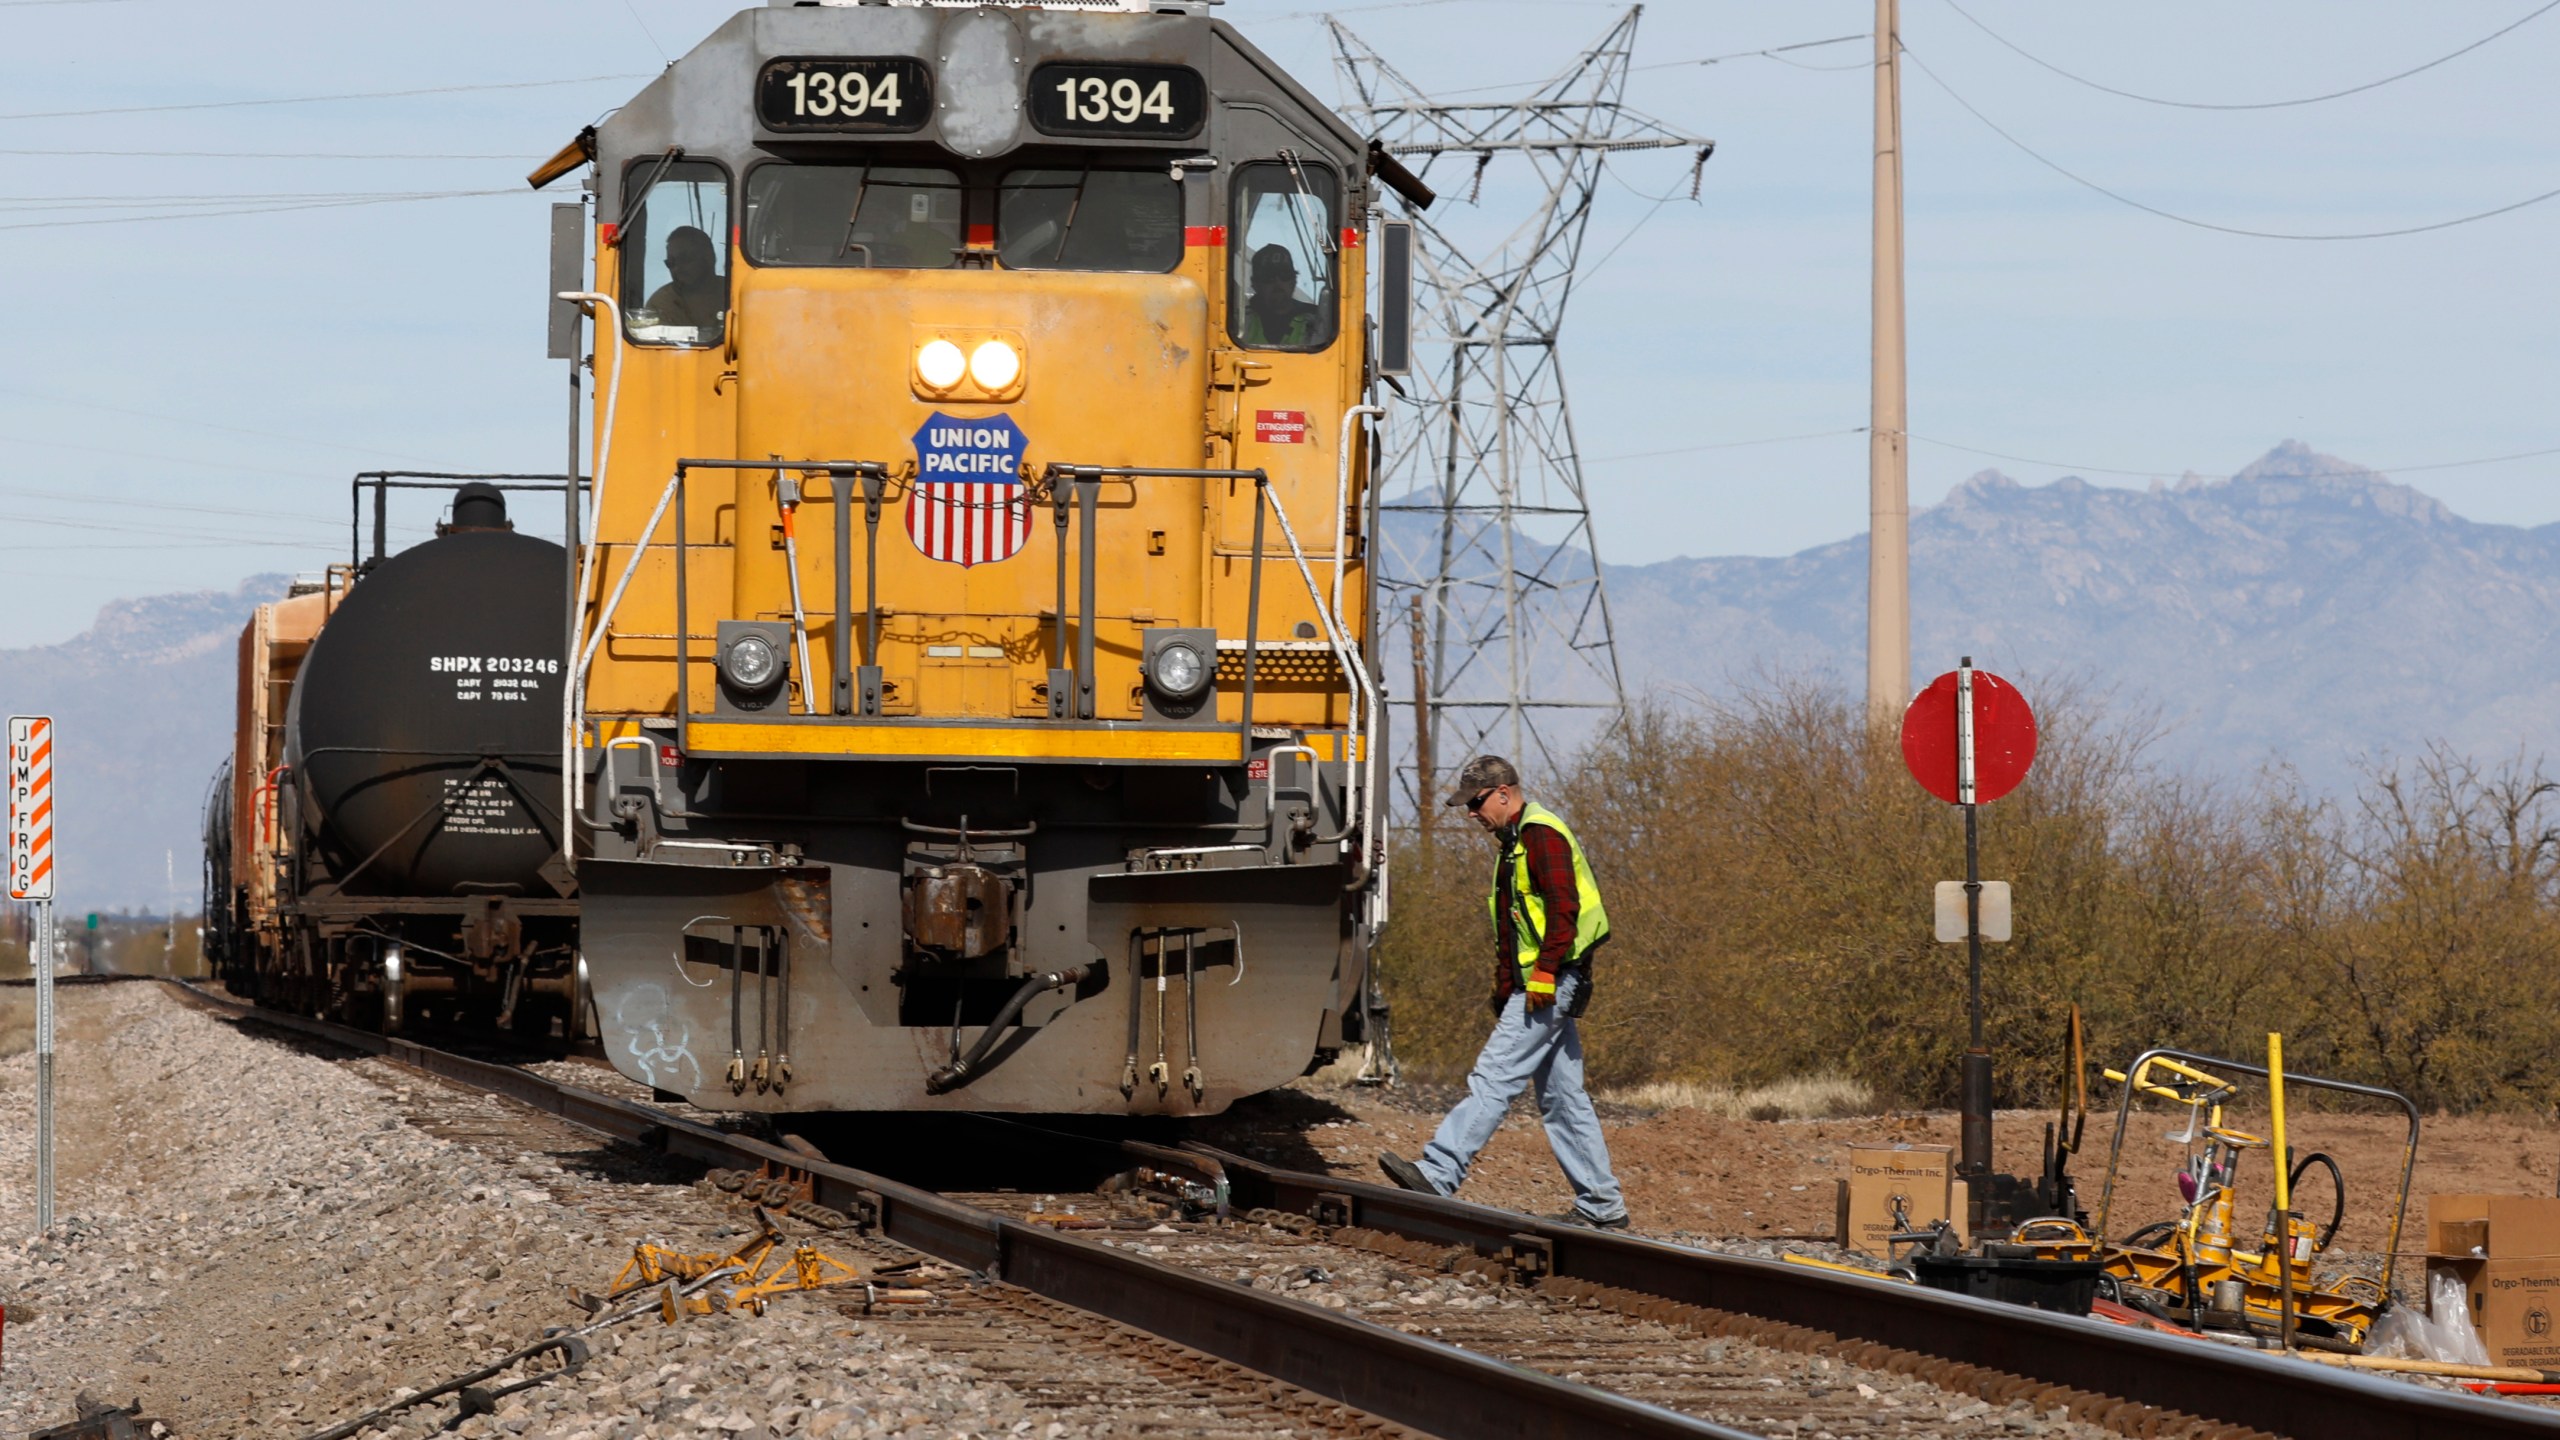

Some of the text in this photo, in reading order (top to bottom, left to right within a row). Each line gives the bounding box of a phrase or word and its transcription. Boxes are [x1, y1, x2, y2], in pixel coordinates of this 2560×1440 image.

[786, 71, 902, 117] 1394
[1056, 77, 1174, 124] 1394
[1273, 412, 1288, 420] FIRE
[1256, 422, 1304, 431] EXTINGUISHER
[930, 428, 1010, 449] UNION
[1269, 434, 1291, 442] INSIDE
[925, 452, 1014, 474] PACIFIC
[430, 656, 558, 674] SHPX 203246
[457, 679, 481, 687] CAPY
[521, 680, 539, 689] GAL
[457, 691, 481, 700] CAPY
[1248, 760, 1265, 769] ATCH
[1255, 770, 1269, 778] STE
[18, 725, 29, 891] JUMP FROG
[1855, 1165, 1944, 1178] Orgo-Thermit Inc.
[2492, 1276, 2560, 1290] Orgo-Thermit
[2502, 1347, 2543, 1356] DEGRADABLE
[2506, 1357, 2560, 1367] CRISOL DEGRADA
